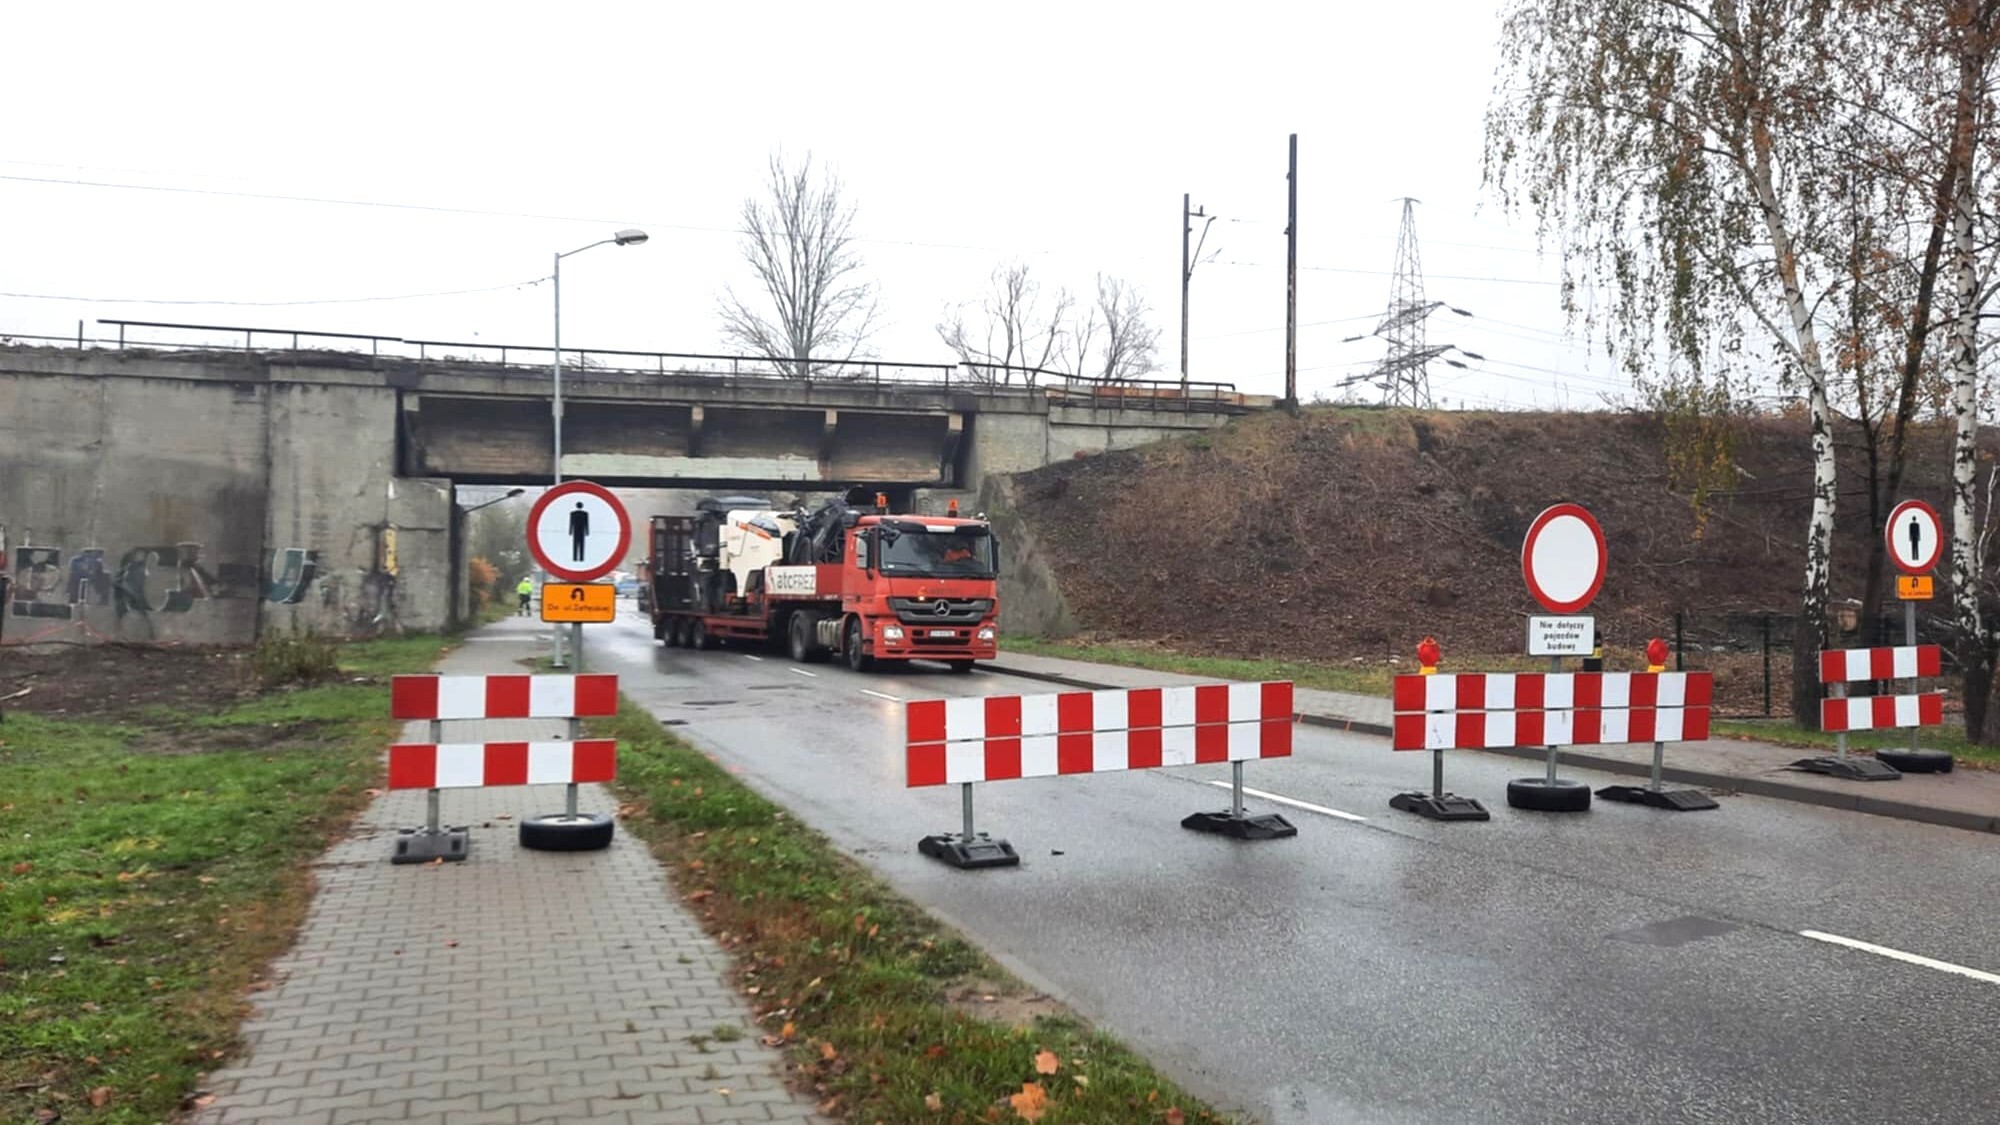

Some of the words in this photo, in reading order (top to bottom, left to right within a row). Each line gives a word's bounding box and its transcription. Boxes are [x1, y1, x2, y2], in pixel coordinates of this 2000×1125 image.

[1540, 620, 1553, 629] Nie
[1556, 620, 1584, 631] dotyczy
[1547, 642, 1576, 651] budowy
